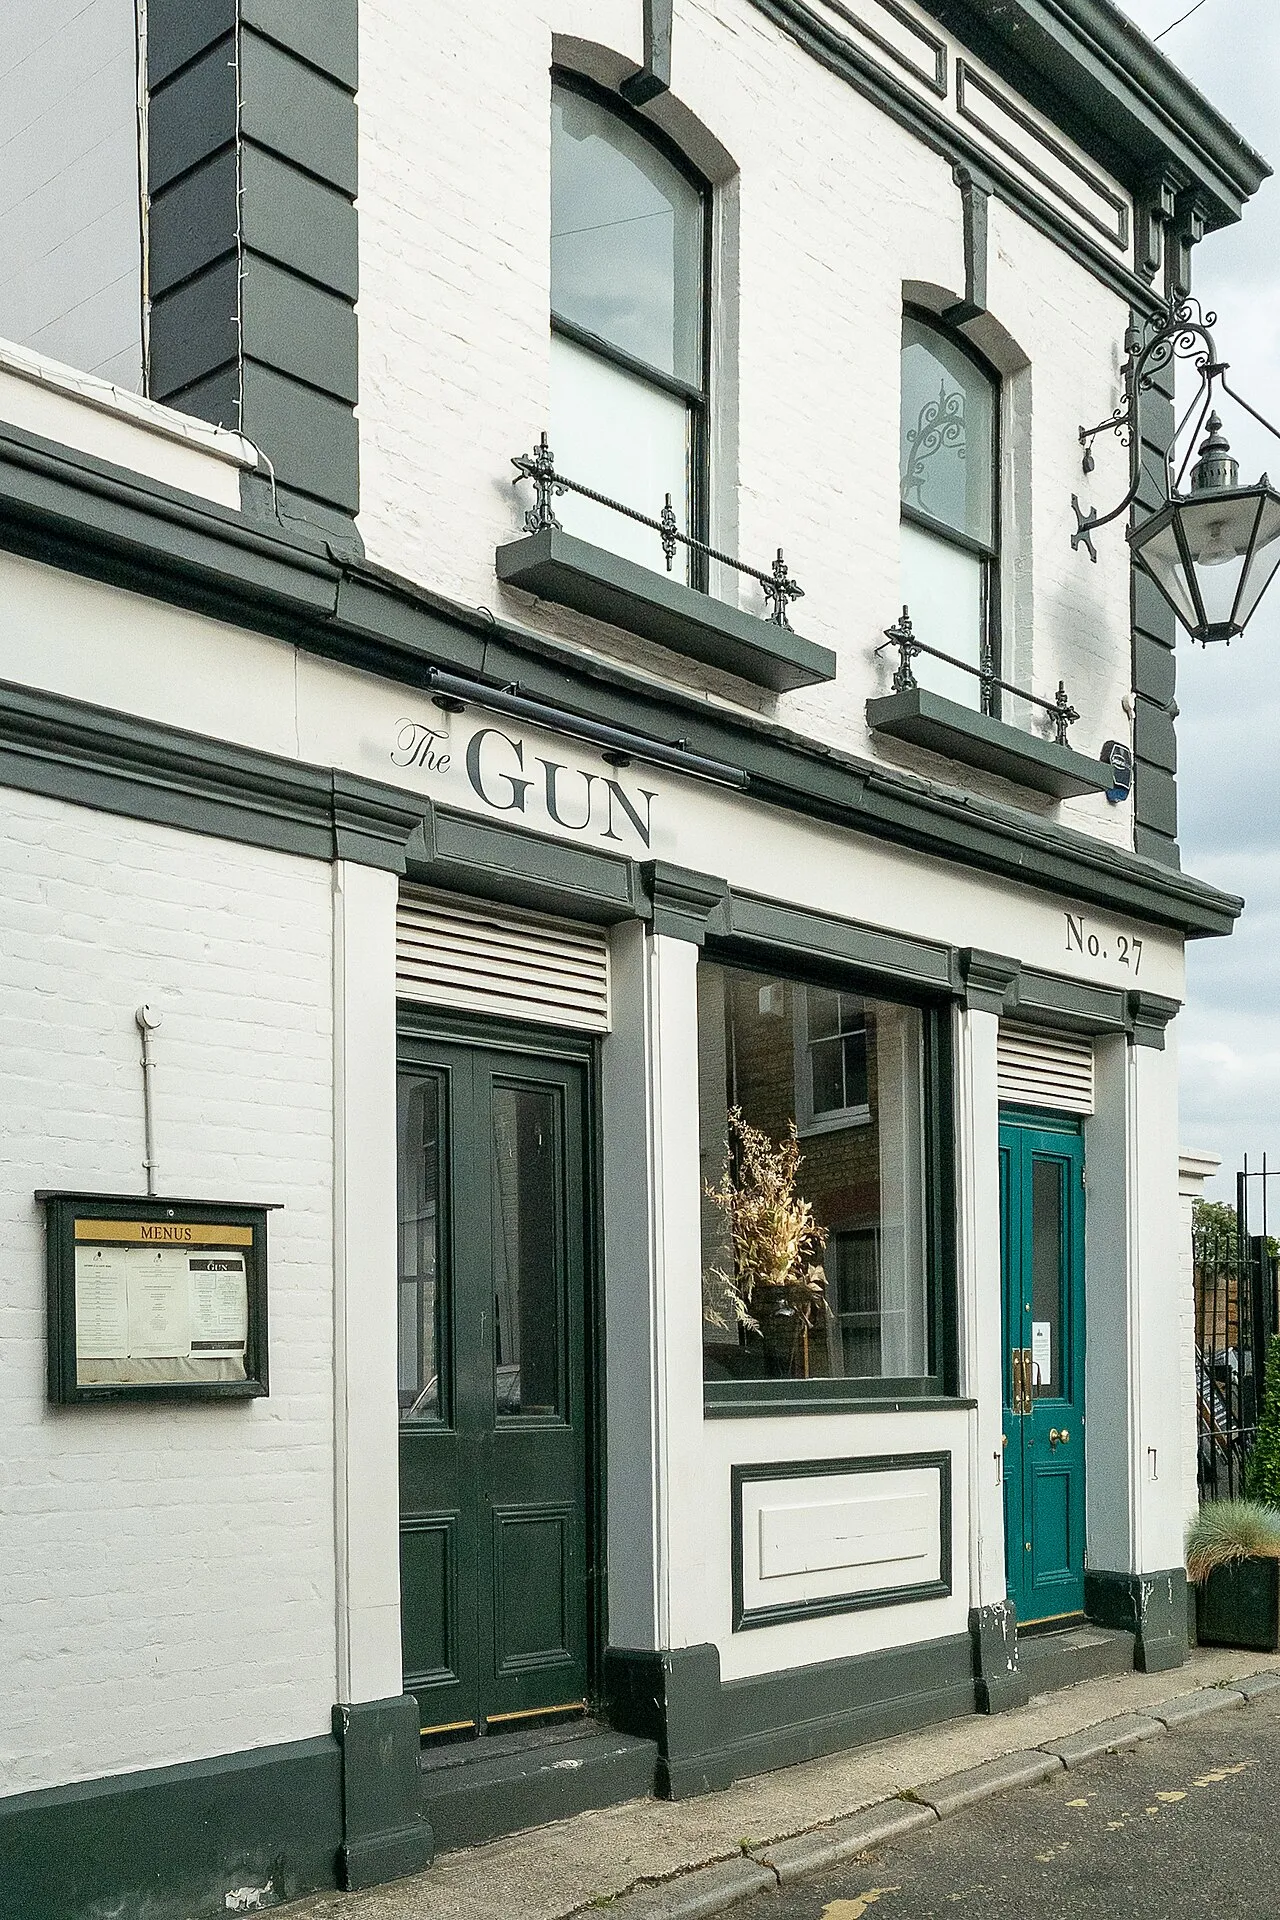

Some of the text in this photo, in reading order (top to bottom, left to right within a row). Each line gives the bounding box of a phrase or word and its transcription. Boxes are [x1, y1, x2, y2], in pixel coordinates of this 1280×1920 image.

[390, 717, 659, 849] The GUN
[1063, 912, 1143, 976] No. 27
[141, 1226, 192, 1241] MENUS
